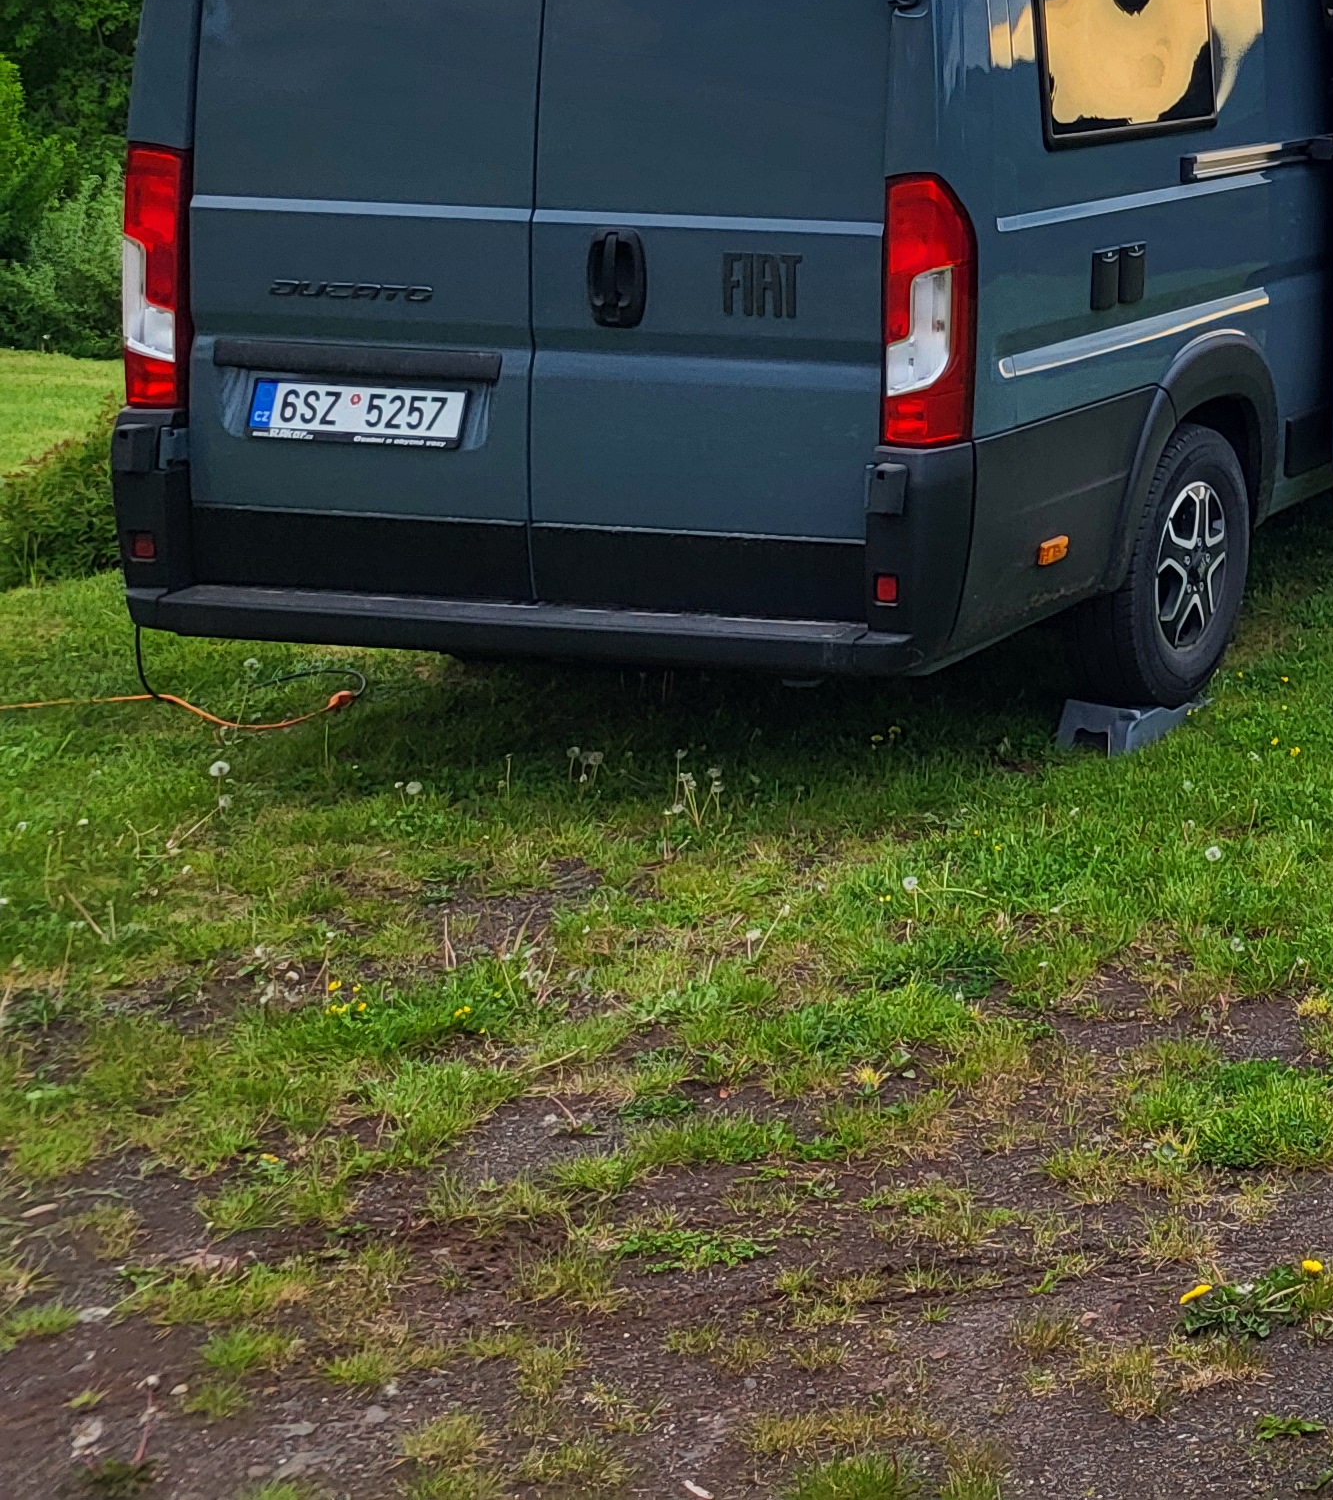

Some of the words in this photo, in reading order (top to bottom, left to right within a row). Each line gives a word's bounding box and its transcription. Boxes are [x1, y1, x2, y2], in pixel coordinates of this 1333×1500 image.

[269, 279, 433, 301] DUCATO
[722, 251, 802, 318] FIAT
[254, 411, 270, 422] CZ
[280, 389, 342, 426] 6SZ
[365, 393, 448, 431] 5257
